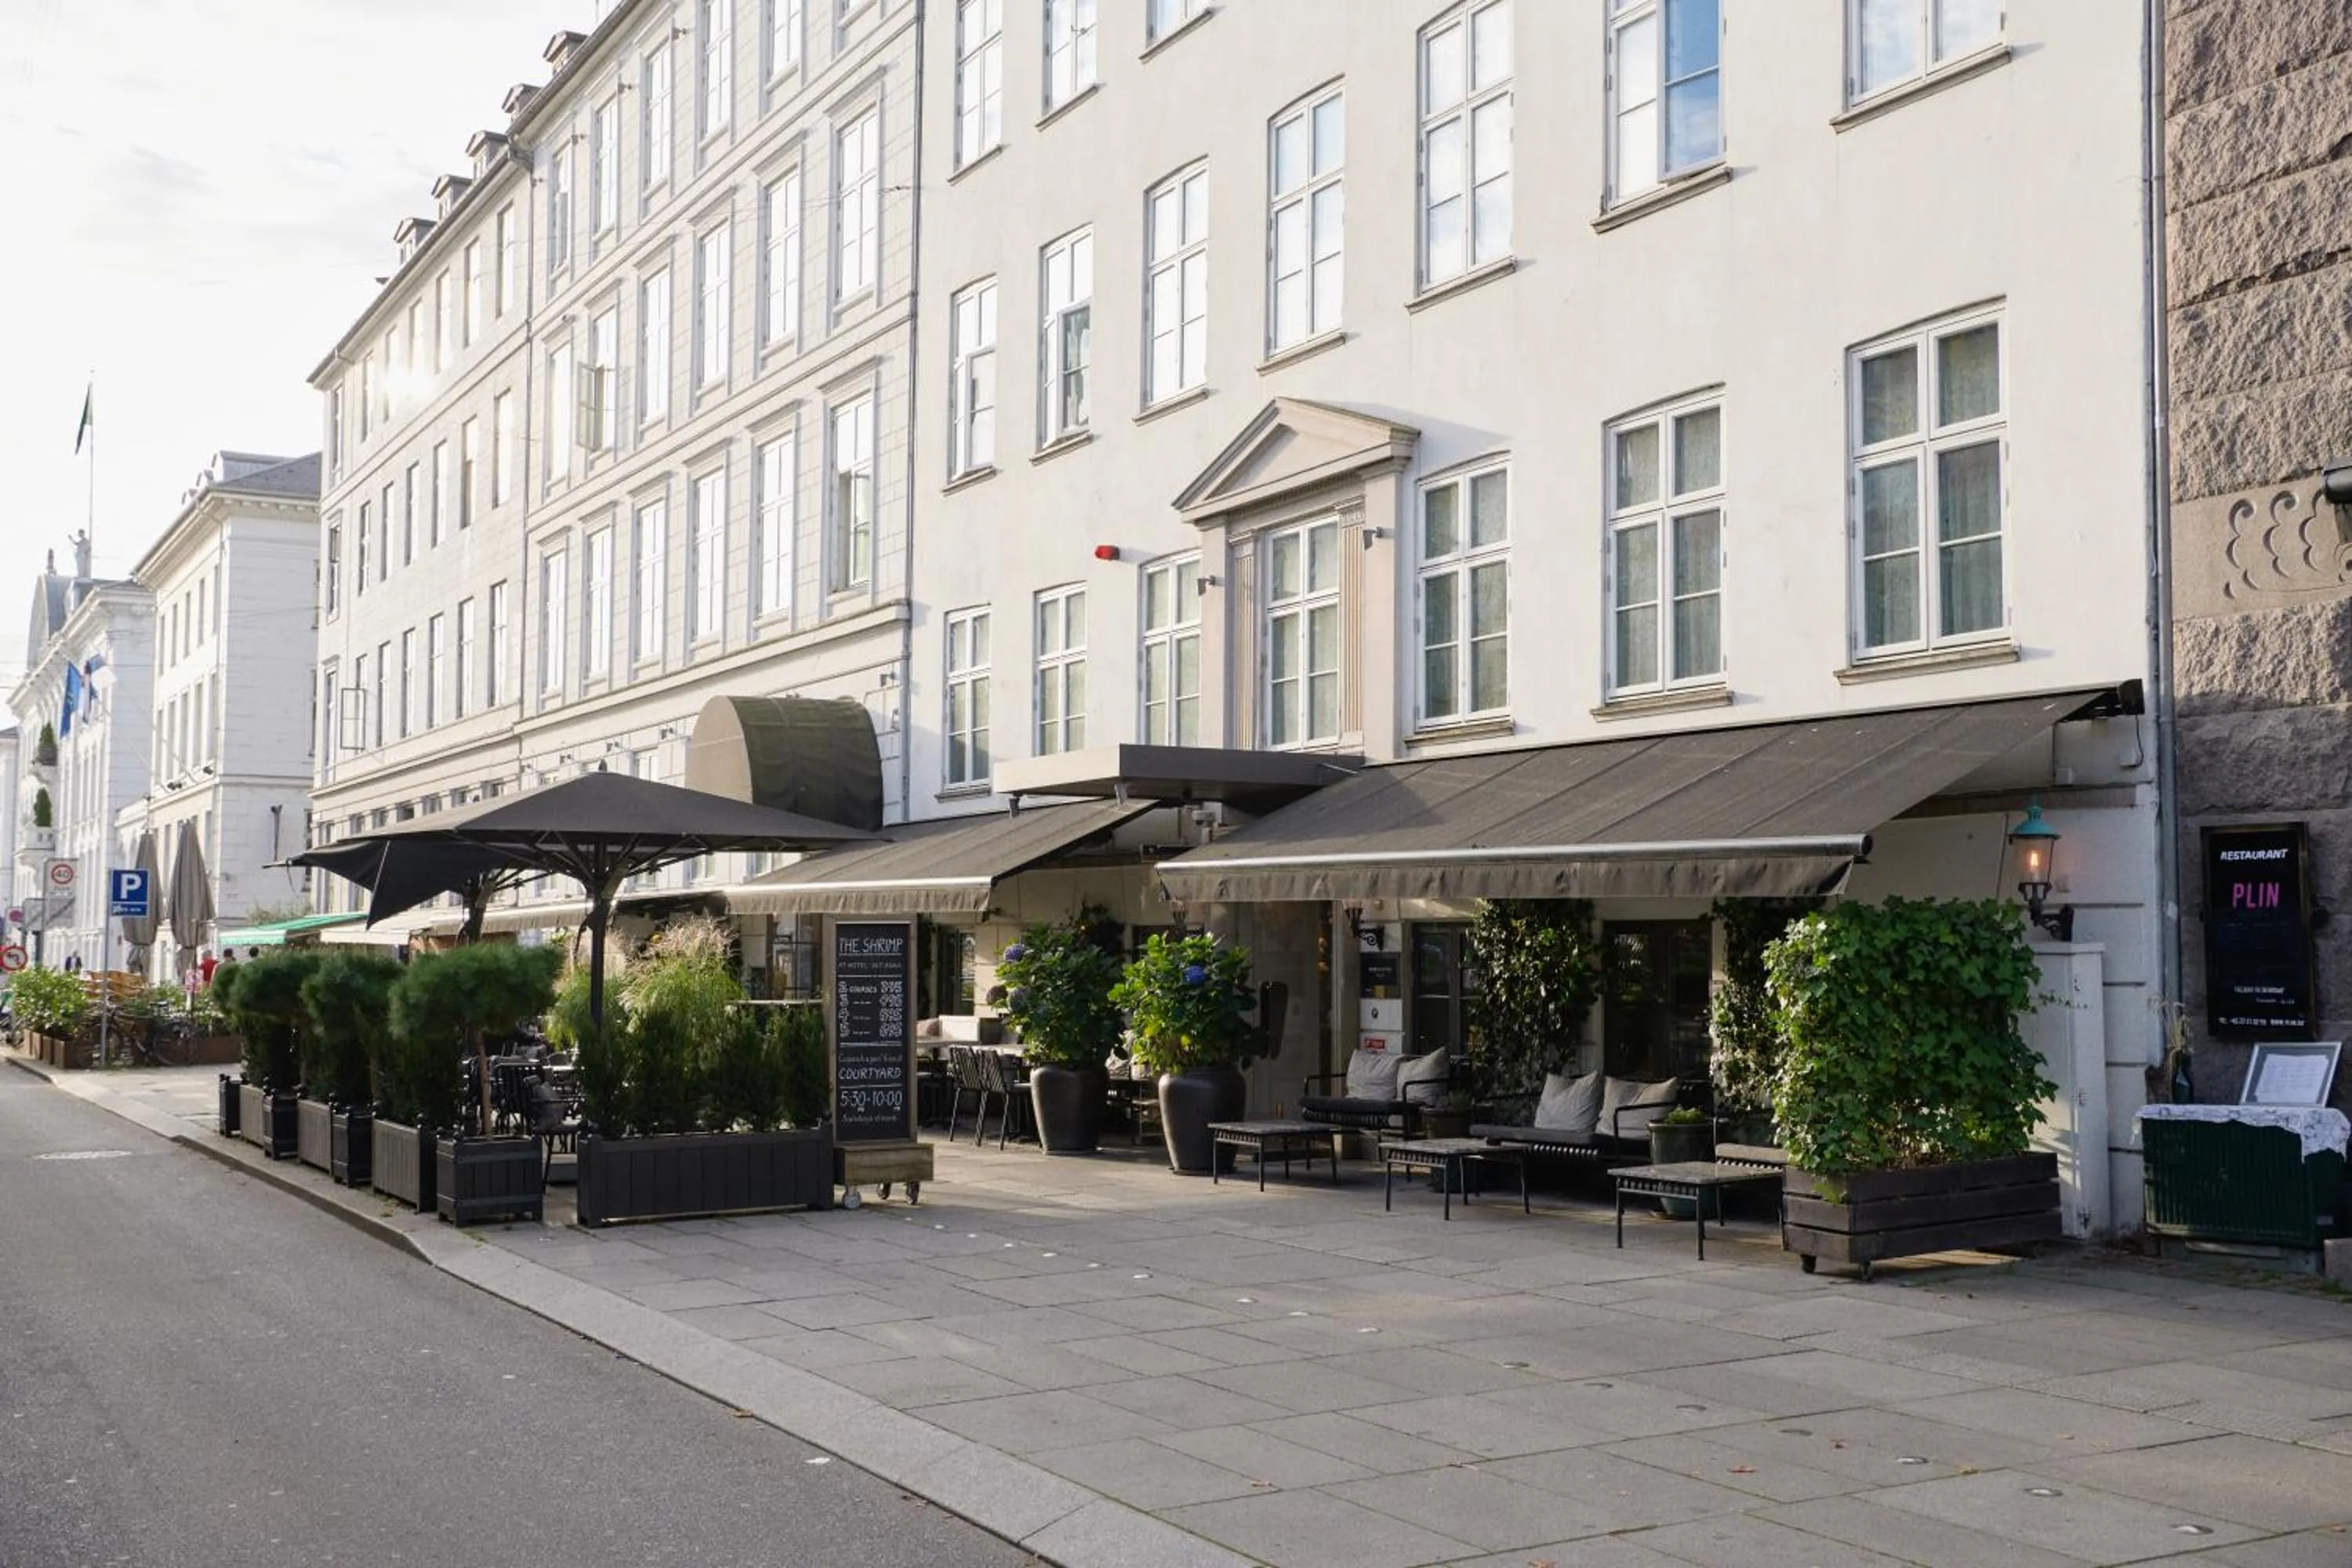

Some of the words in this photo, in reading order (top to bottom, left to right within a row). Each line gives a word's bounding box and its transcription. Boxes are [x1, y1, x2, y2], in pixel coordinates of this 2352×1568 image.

[2220, 848, 2288, 860] RESTAURANT
[121, 873, 142, 898] P
[2232, 882, 2280, 909] PLIN
[840, 938, 860, 953] THE
[862, 938, 903, 953] SHRIMP
[838, 1067, 902, 1080] COURTYARD
